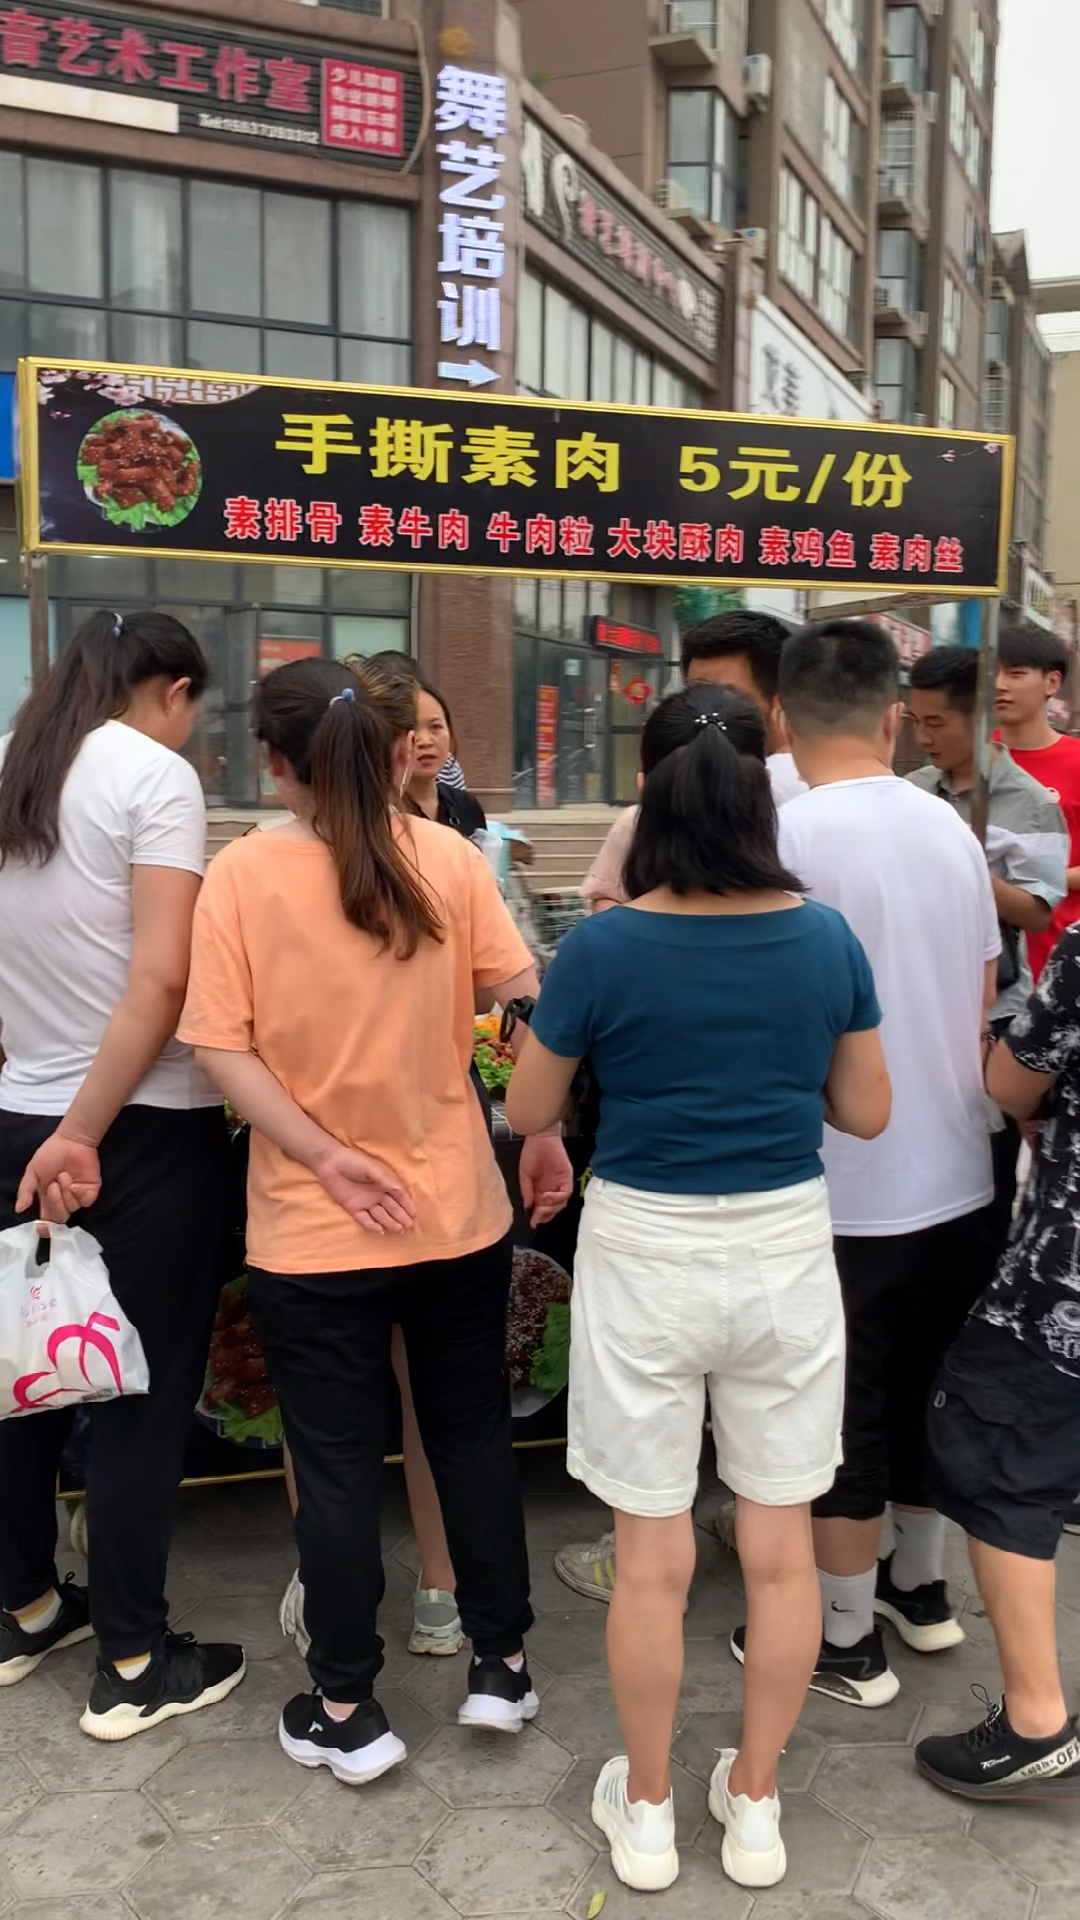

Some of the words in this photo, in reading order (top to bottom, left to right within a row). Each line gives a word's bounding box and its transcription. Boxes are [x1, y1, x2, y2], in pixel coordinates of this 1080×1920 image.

[0, 7, 313, 113] 音艺术工作室
[435, 65, 506, 351] 舞艺培训
[275, 411, 621, 495] 手撕素肉
[679, 446, 912, 508] 5元/份
[224, 496, 342, 544] 素排骨
[358, 504, 469, 550] 素牛肉
[486, 511, 594, 556] 牛肉粒
[606, 517, 744, 564] 大块酥肉
[758, 526, 856, 568] 素鸡鱼
[868, 532, 964, 573] 素肉丝
